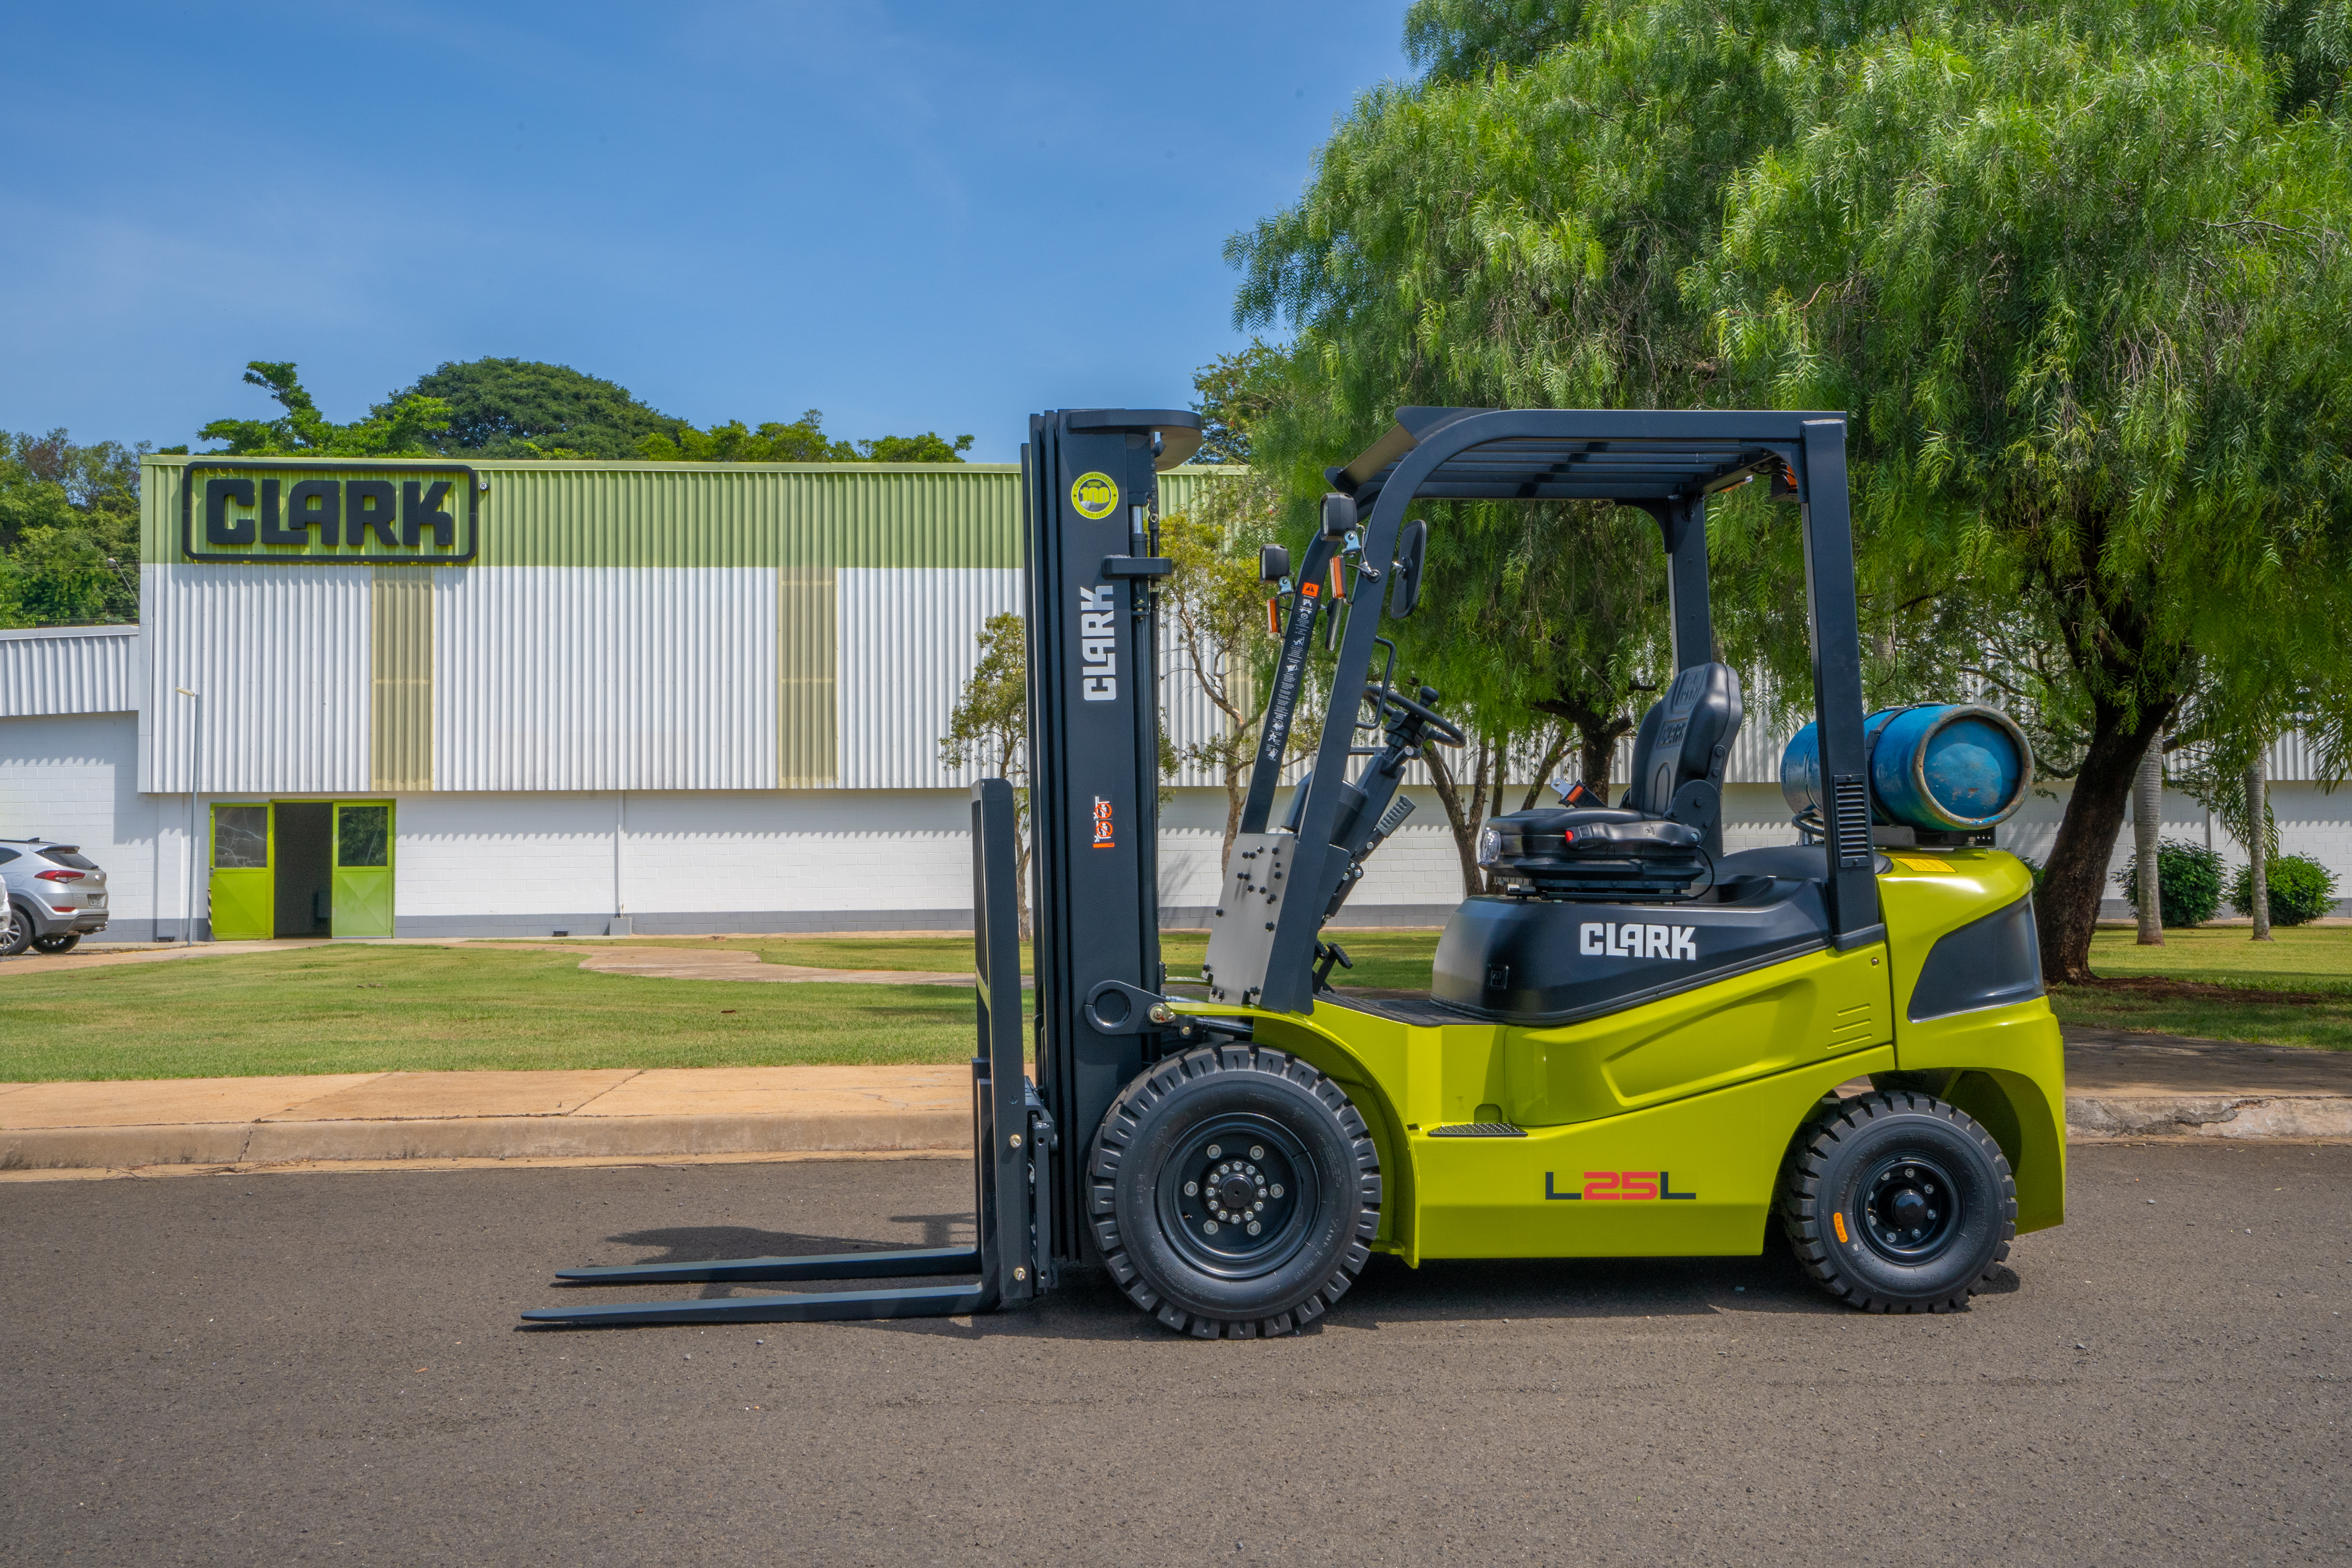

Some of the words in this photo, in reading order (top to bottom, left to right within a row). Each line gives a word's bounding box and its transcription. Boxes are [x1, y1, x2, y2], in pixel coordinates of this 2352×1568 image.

[1074, 475, 1087, 491] CLARK
[1095, 474, 1116, 490] FORKLIFT
[1080, 487, 1110, 504] 100
[206, 479, 453, 546] CLARK
[1086, 499, 1102, 510] Years
[1080, 586, 1116, 701] CLARK
[1580, 923, 1696, 960] CLARK
[1545, 1171, 1696, 1200] L25L
